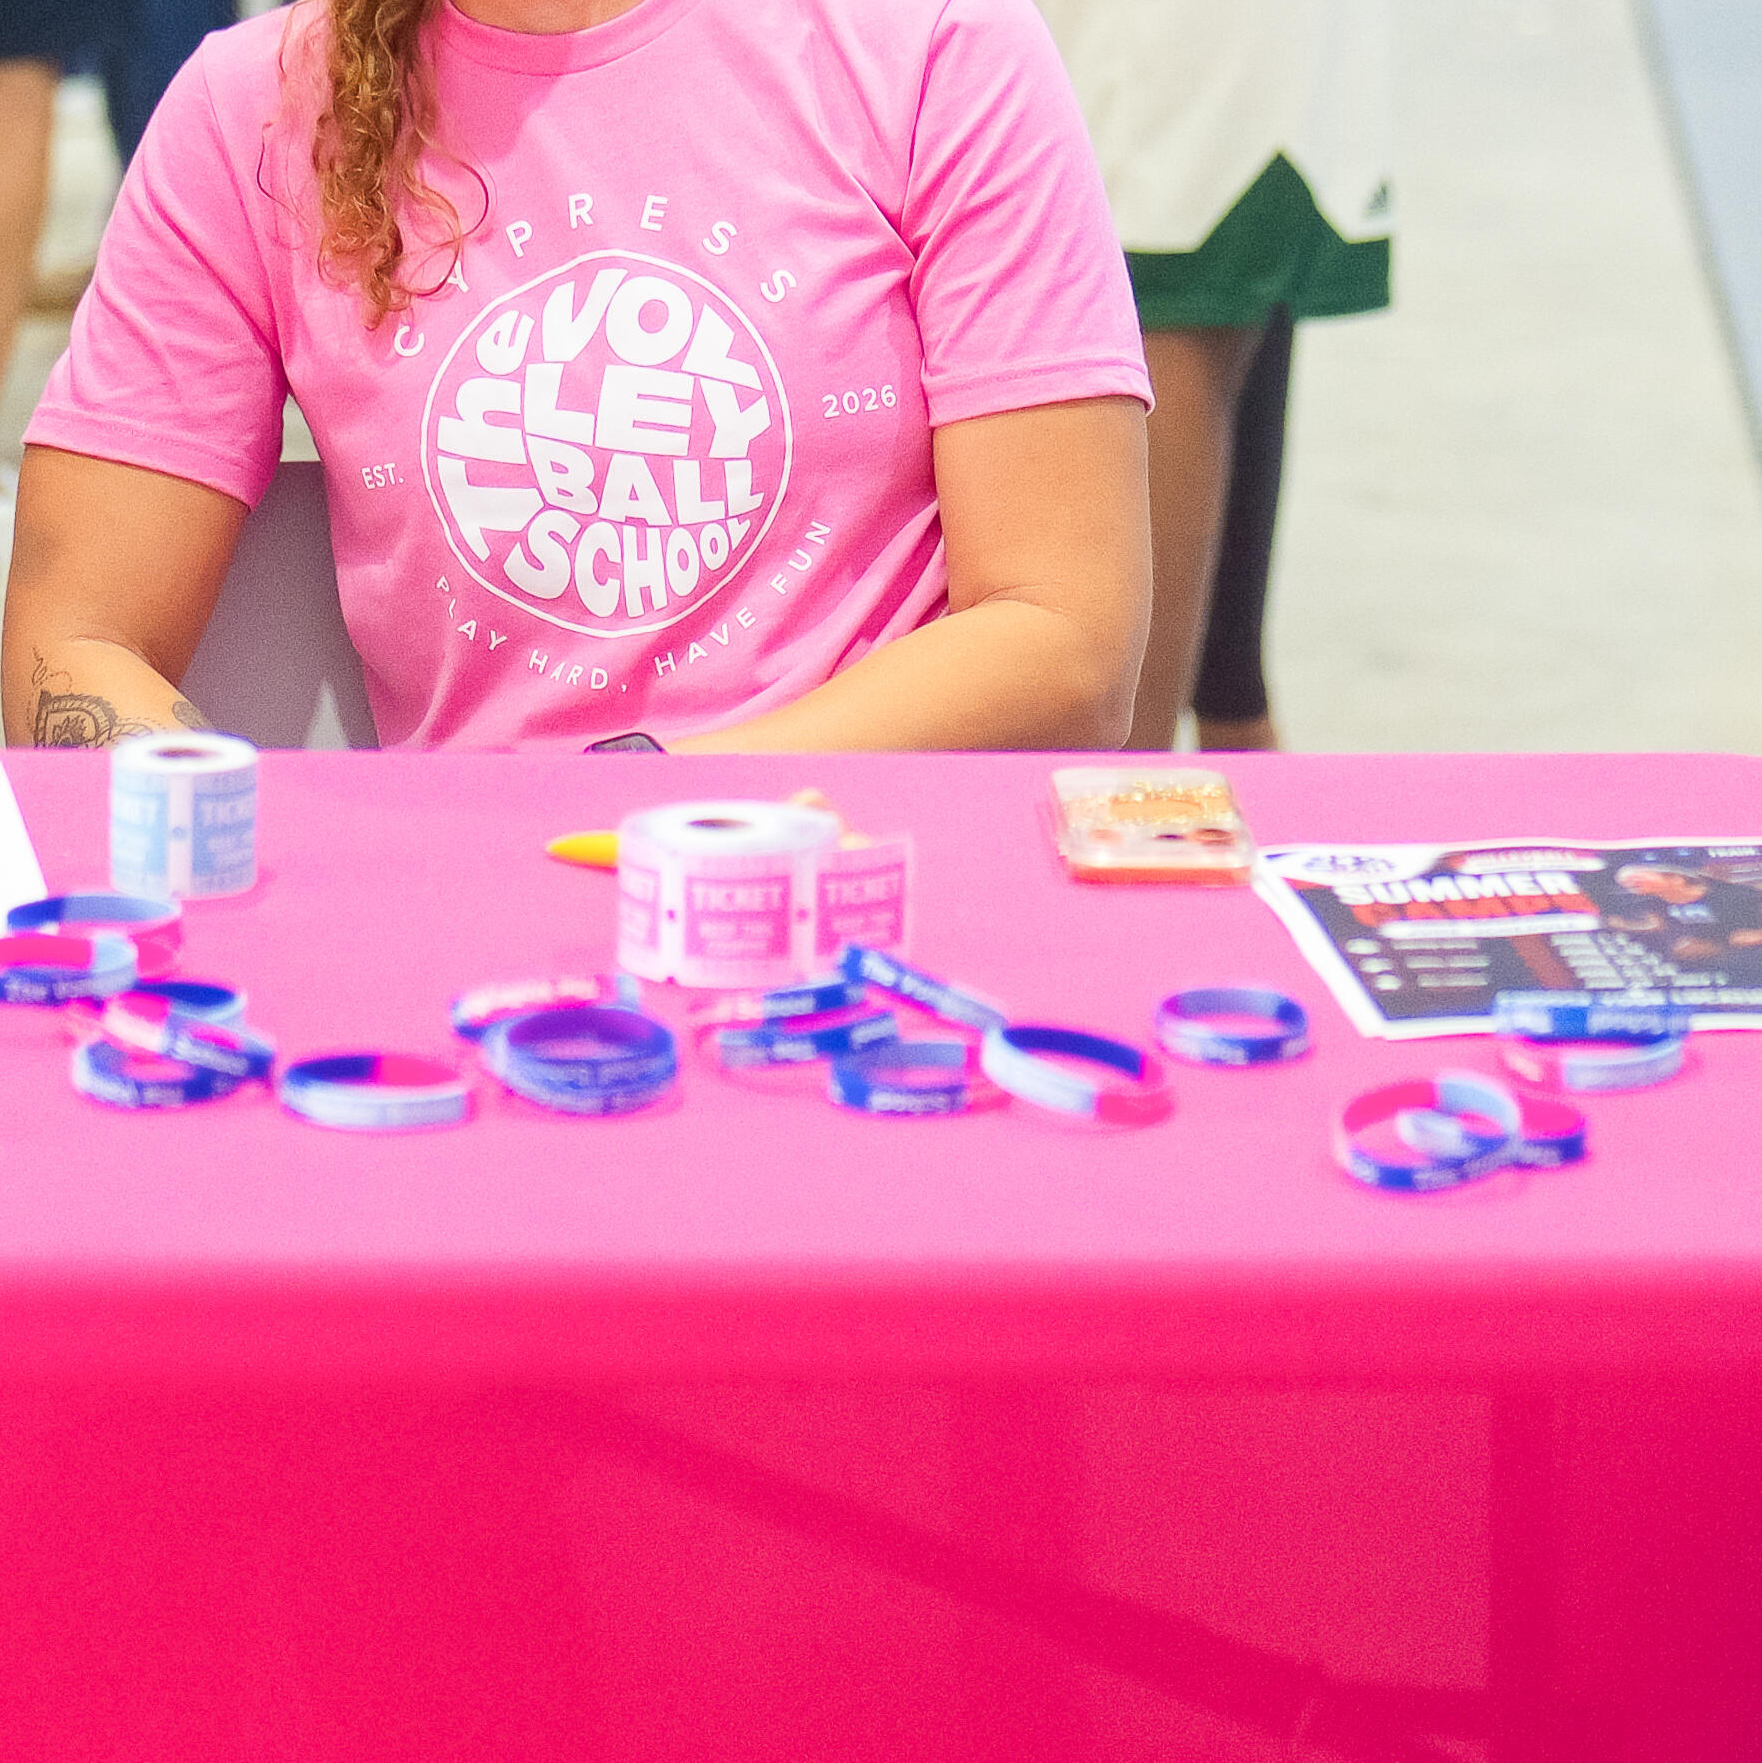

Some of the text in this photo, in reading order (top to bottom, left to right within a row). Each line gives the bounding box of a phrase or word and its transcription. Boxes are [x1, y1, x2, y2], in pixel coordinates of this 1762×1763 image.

[392, 193, 797, 359] CYPRESS
[438, 308, 544, 564] The
[822, 384, 899, 420] 2026
[361, 461, 406, 491] EST.
[524, 434, 765, 527] BALL
[434, 575, 509, 652] PLAY
[654, 605, 759, 679] HAVE
[770, 519, 833, 597] FUN
[504, 509, 751, 618] SCHOOL
[1334, 870, 1581, 907] SUMMER
